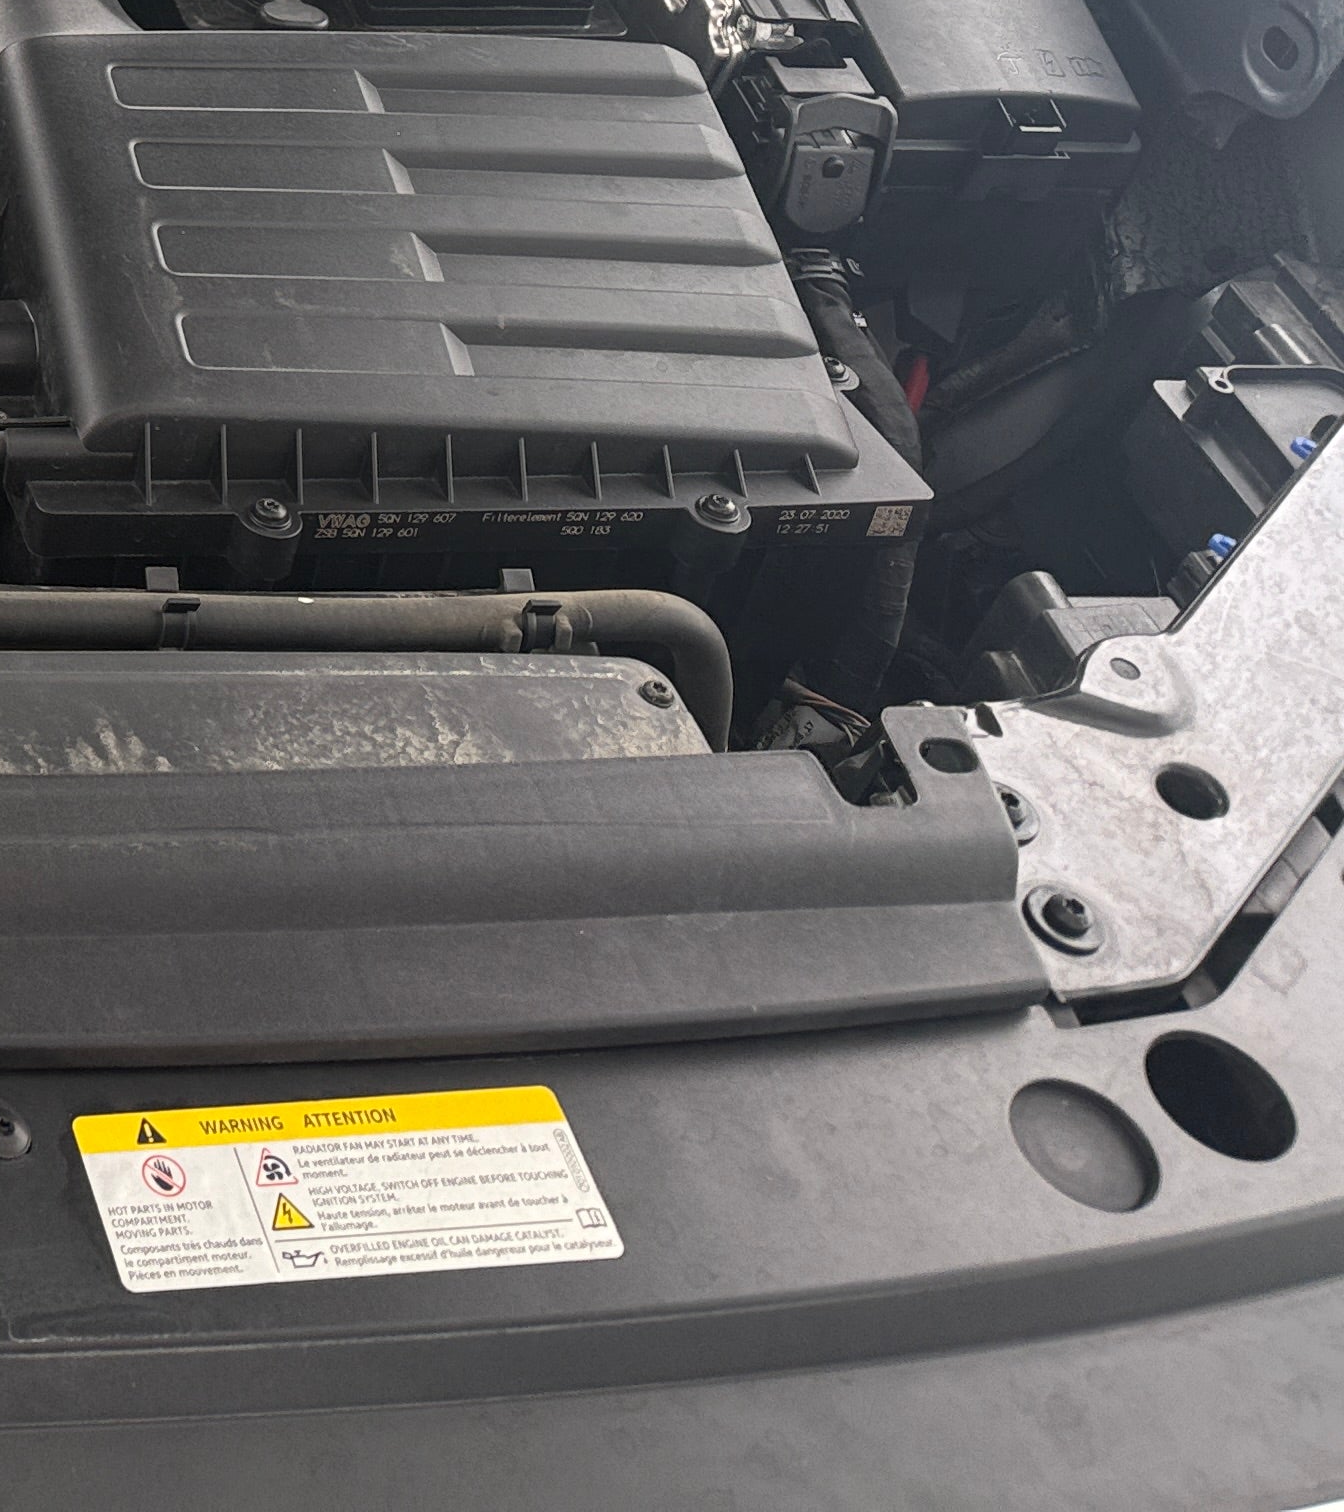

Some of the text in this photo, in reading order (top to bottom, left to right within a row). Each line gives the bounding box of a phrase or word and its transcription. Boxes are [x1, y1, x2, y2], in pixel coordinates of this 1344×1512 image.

[432, 513, 457, 522] 607
[199, 1108, 397, 1135] WARNING ATTENTION
[292, 1143, 341, 1155] RADIATOR
[343, 1141, 363, 1151] FAN
[365, 1140, 385, 1150] MAY
[387, 1139, 415, 1148] START
[418, 1138, 429, 1146] AT
[431, 1136, 450, 1145] ANY
[308, 1169, 568, 1196] HIGH SWITCH OFF ENGINE BEFORE TOUCHING
[108, 1200, 212, 1216] HOT PARTS IN MOTOR
[312, 1196, 357, 1207] IGNITION
[112, 1215, 191, 1228] COMPARTMENT.
[115, 1226, 193, 1240] MOVING PARTS.
[120, 1240, 181, 1256] Composants
[203, 1239, 238, 1250] chauds
[239, 1238, 263, 1246] dans
[330, 1243, 390, 1254] OVERFILLED
[392, 1239, 429, 1250] ENGINE
[431, 1238, 448, 1247] OIL
[449, 1235, 470, 1246] CAN
[471, 1232, 513, 1244] DAMAGE
[124, 1257, 134, 1267] le
[136, 1254, 209, 1268] compartiment
